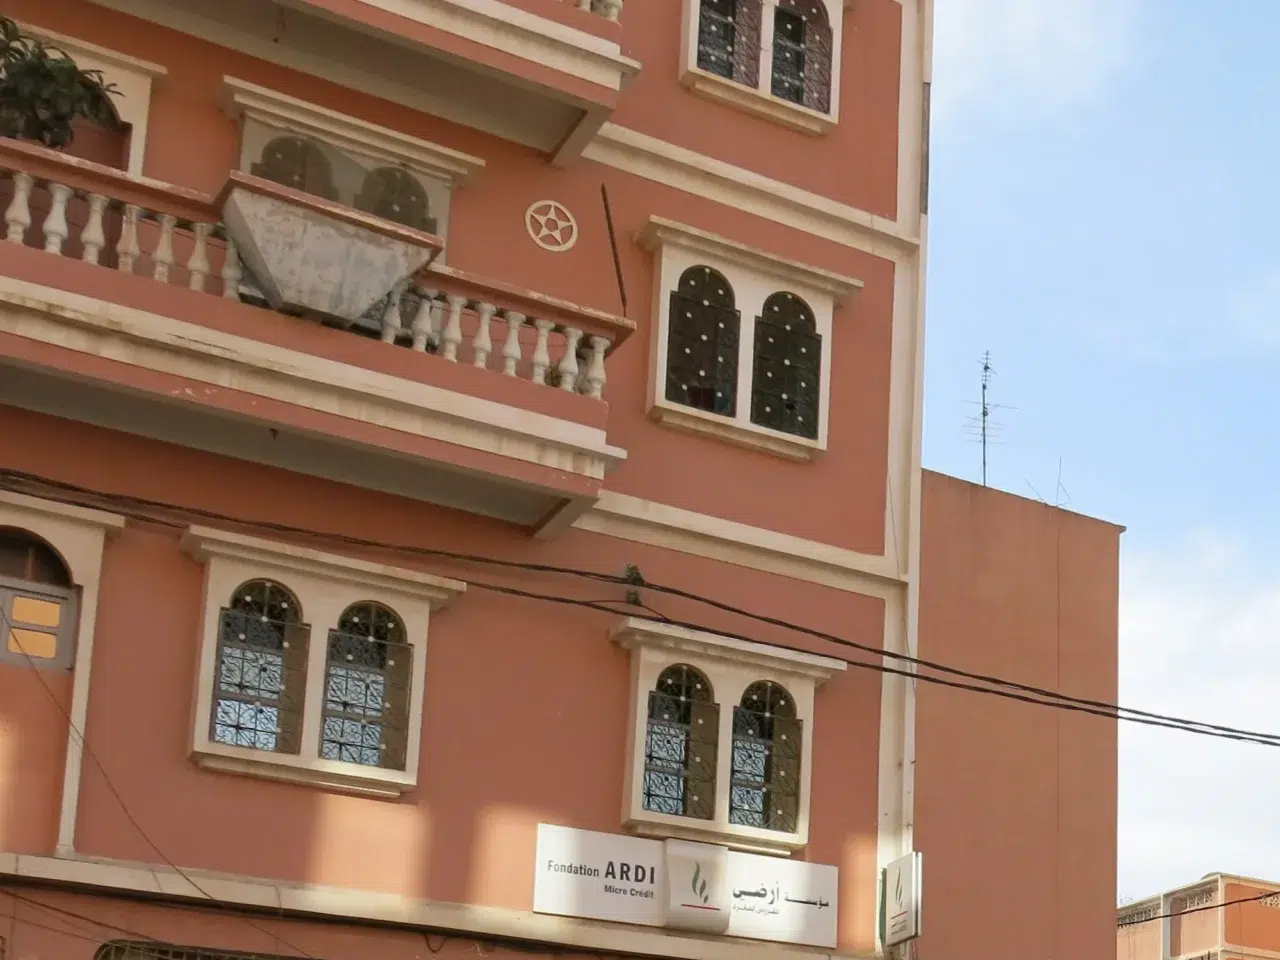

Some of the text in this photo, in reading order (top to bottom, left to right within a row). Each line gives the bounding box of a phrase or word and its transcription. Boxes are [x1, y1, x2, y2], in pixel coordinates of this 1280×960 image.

[547, 860, 655, 884] Fondation ARDI
[604, 884, 655, 898] Micro Crédit
[732, 880, 830, 909] مؤسسة أرضي
